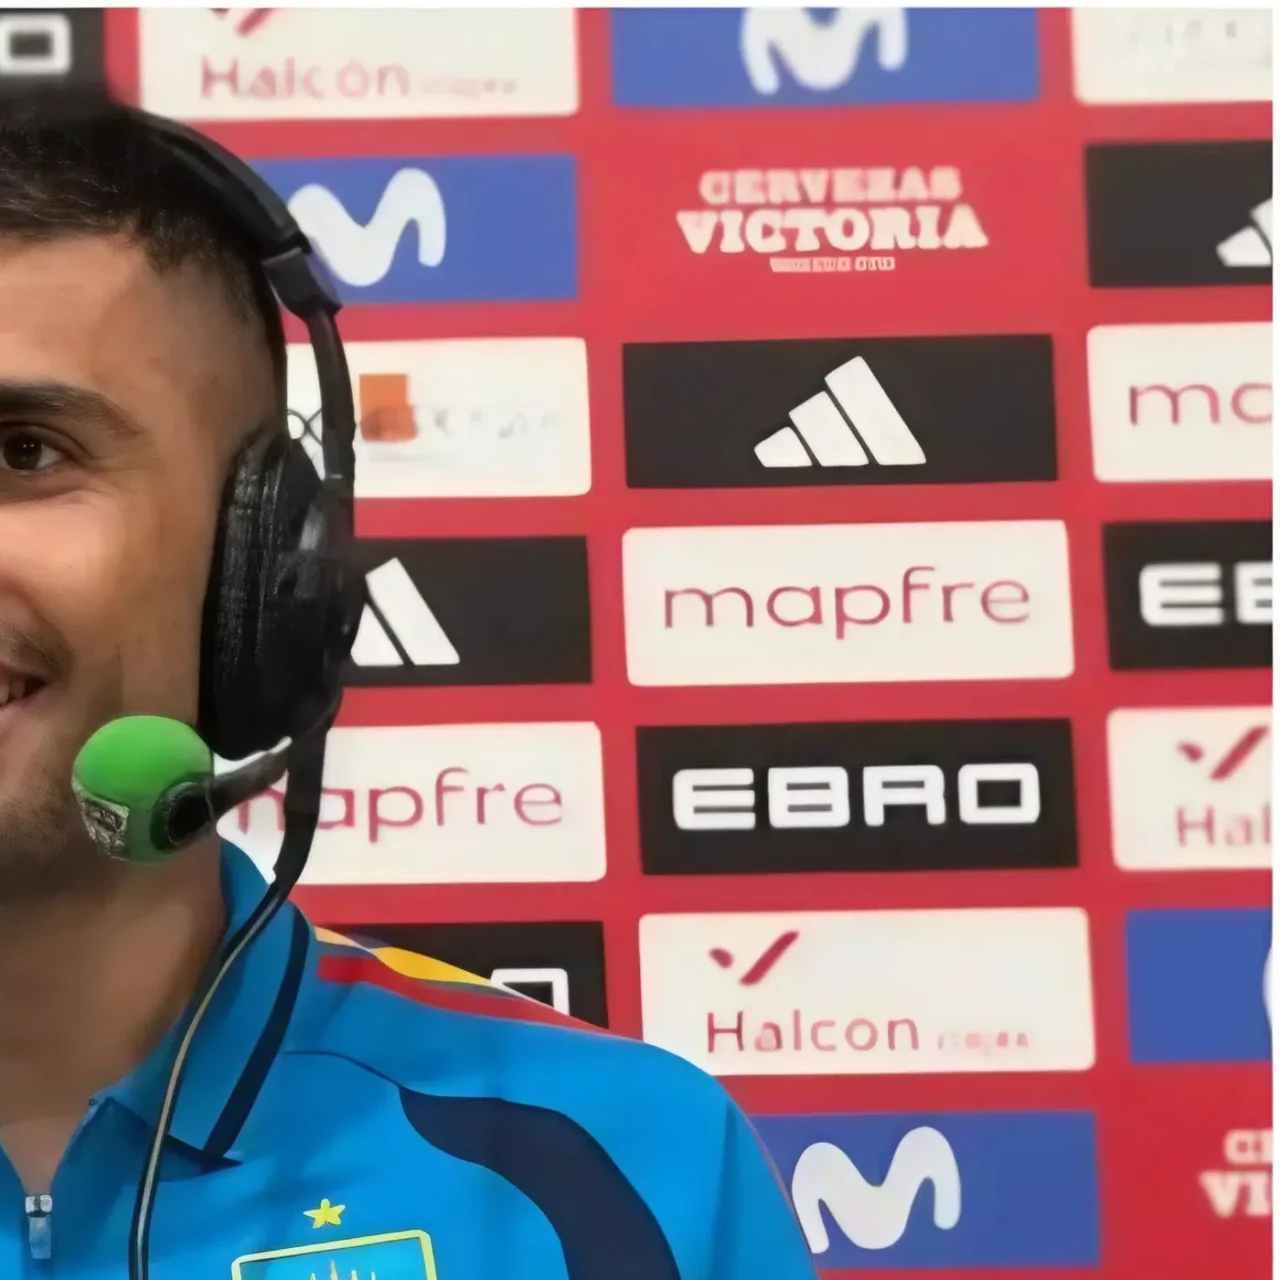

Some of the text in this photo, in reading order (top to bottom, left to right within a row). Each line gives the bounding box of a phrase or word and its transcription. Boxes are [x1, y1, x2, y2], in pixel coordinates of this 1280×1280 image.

[675, 202, 989, 254] VICTORIA
[663, 565, 1031, 640] mapfre
[672, 763, 1041, 831] EBRO
